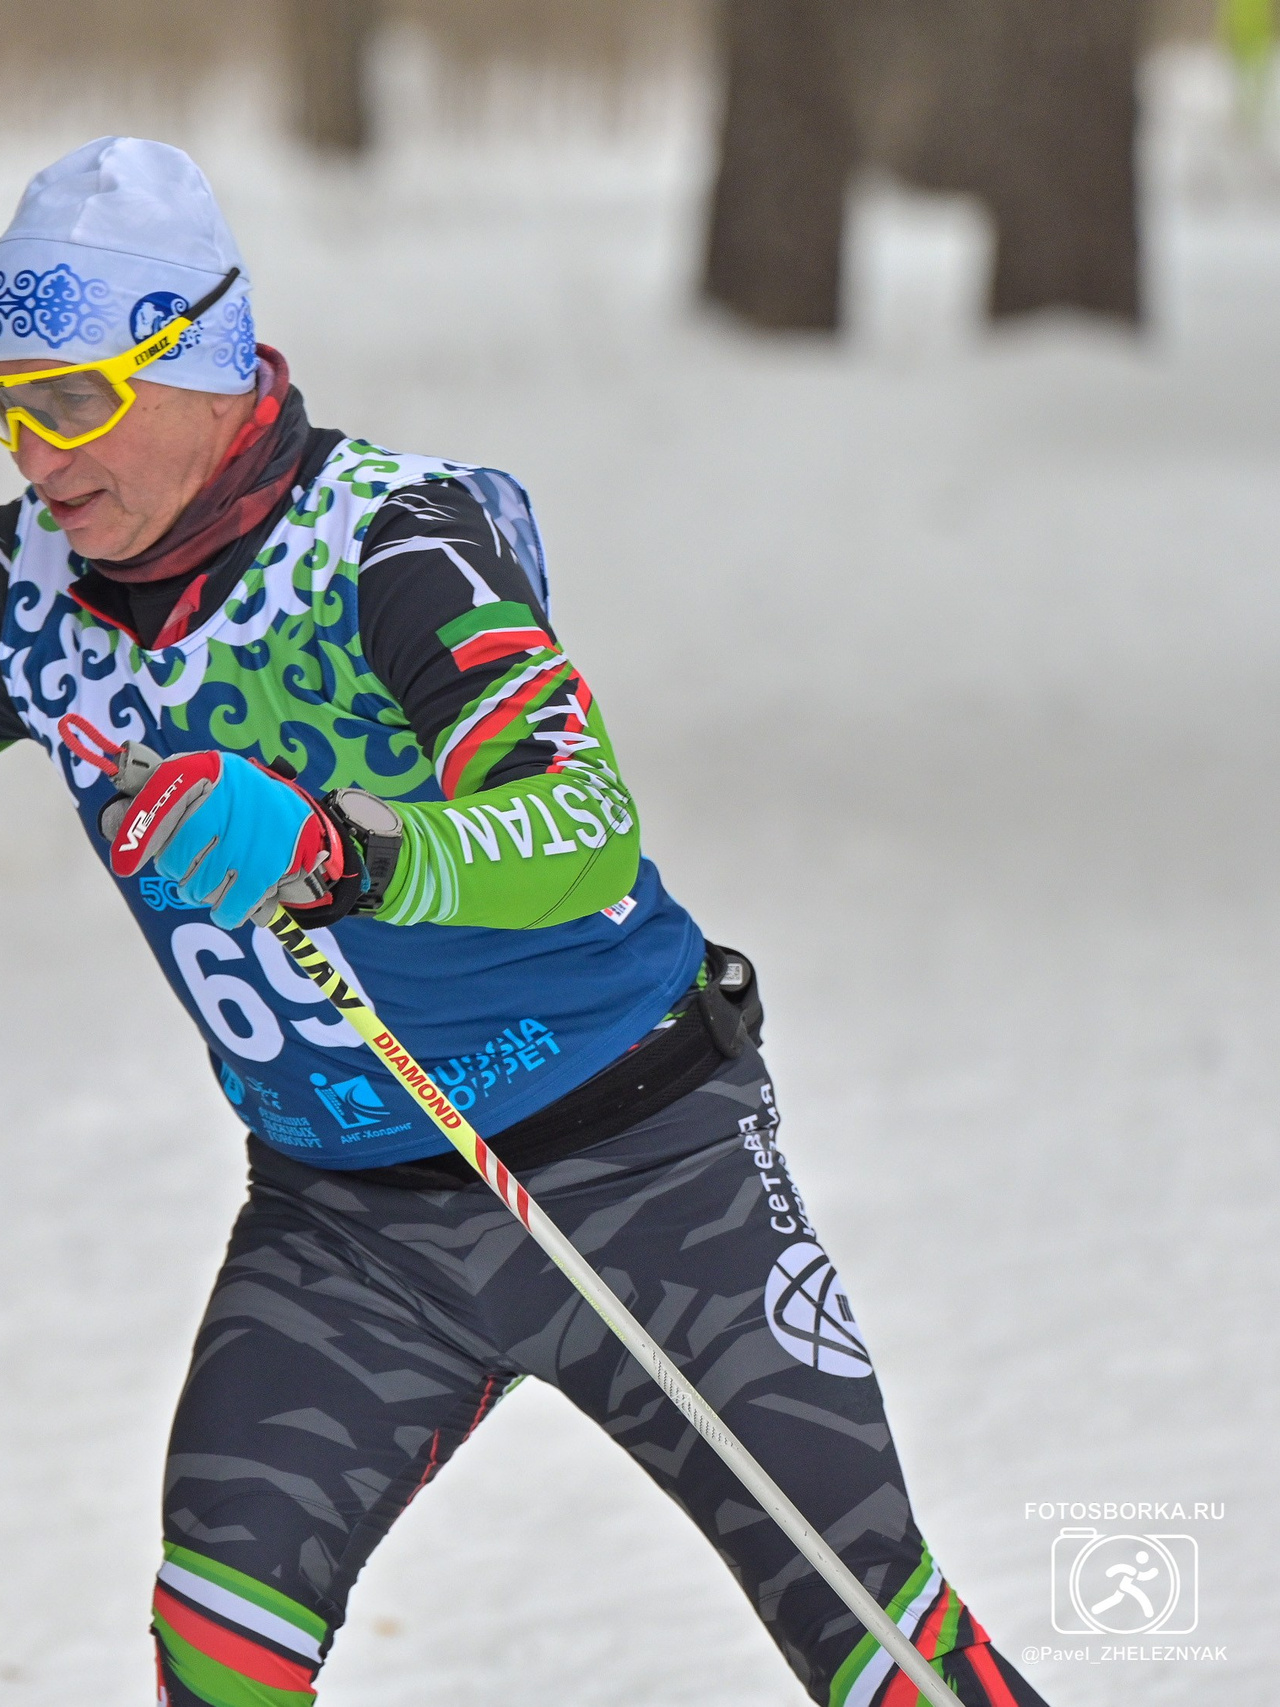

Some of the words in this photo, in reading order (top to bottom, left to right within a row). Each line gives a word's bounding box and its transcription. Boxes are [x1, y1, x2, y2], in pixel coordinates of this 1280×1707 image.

[171, 922, 376, 1063] 69
[269, 911, 366, 1008] WAY
[372, 1031, 462, 1129] DIAMOND
[426, 1018, 548, 1092] USSIA
[448, 1031, 560, 1111] OPPET
[738, 1114, 797, 1234] Сетевя
[569, 1276, 600, 1311] DIAMOND
[598, 1310, 627, 1342] CARBON
